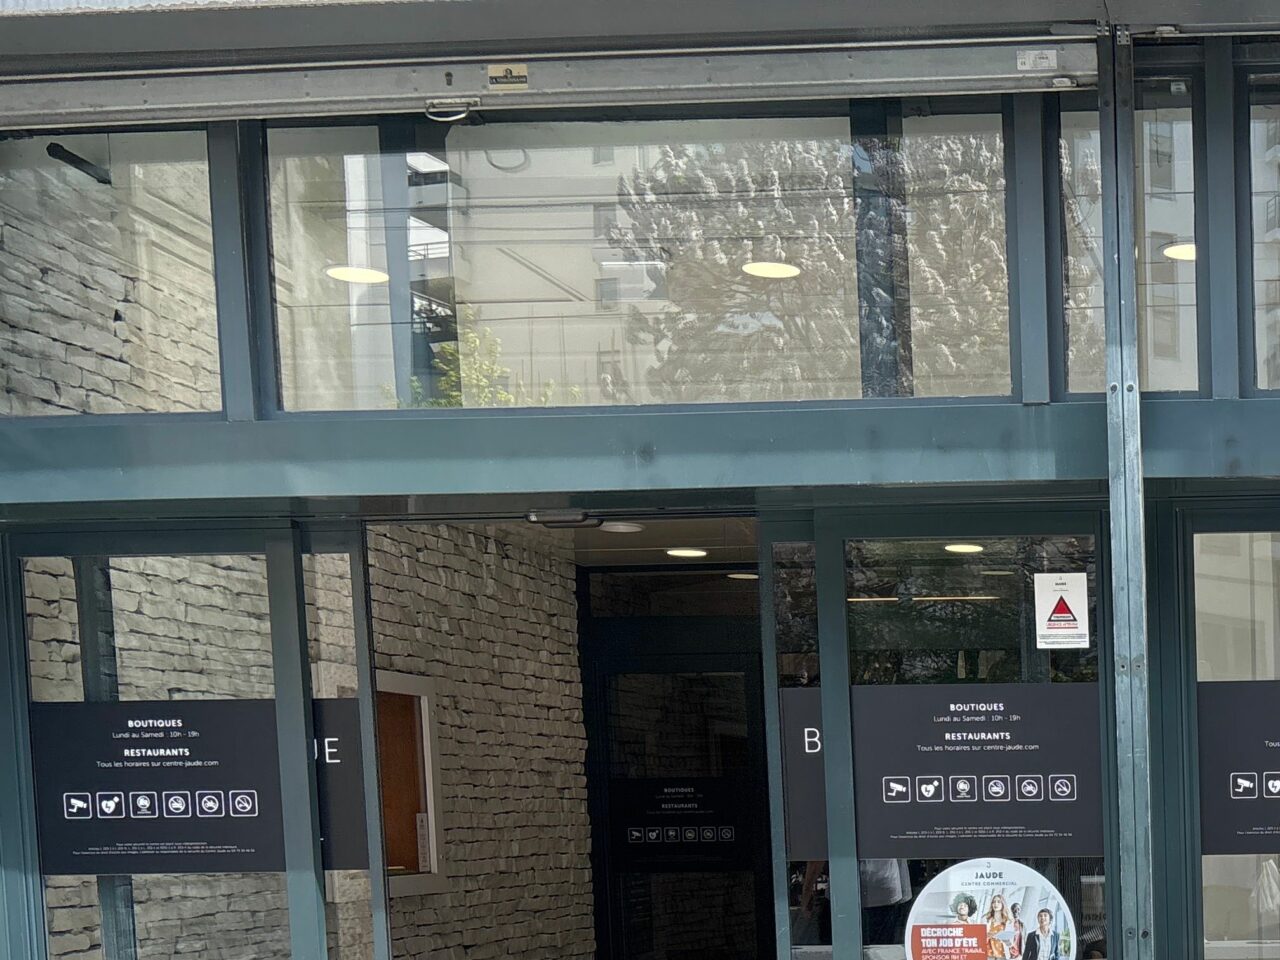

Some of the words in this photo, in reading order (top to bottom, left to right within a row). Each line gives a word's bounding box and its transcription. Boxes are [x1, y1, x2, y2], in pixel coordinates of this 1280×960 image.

[950, 703, 1004, 711] BOUTIQUES
[933, 715, 951, 723] Lundi
[991, 714, 1004, 722] 10h
[112, 731, 129, 739] Lundi
[140, 731, 165, 739] Samedi
[169, 730, 182, 738] 10h
[187, 730, 200, 738] 19h
[916, 744, 932, 752] Tous
[945, 743, 970, 751] horaires
[982, 742, 1039, 752] centre-jaude.com
[1264, 740, 1280, 748] Tous
[96, 760, 112, 768] Tous
[113, 760, 123, 768] les
[124, 759, 150, 767] horaires
[162, 759, 219, 768] centre-jaude.com
[920, 927, 964, 937] DÉCROCHE
[921, 938, 937, 948] TON
[938, 938, 954, 948] JOB
